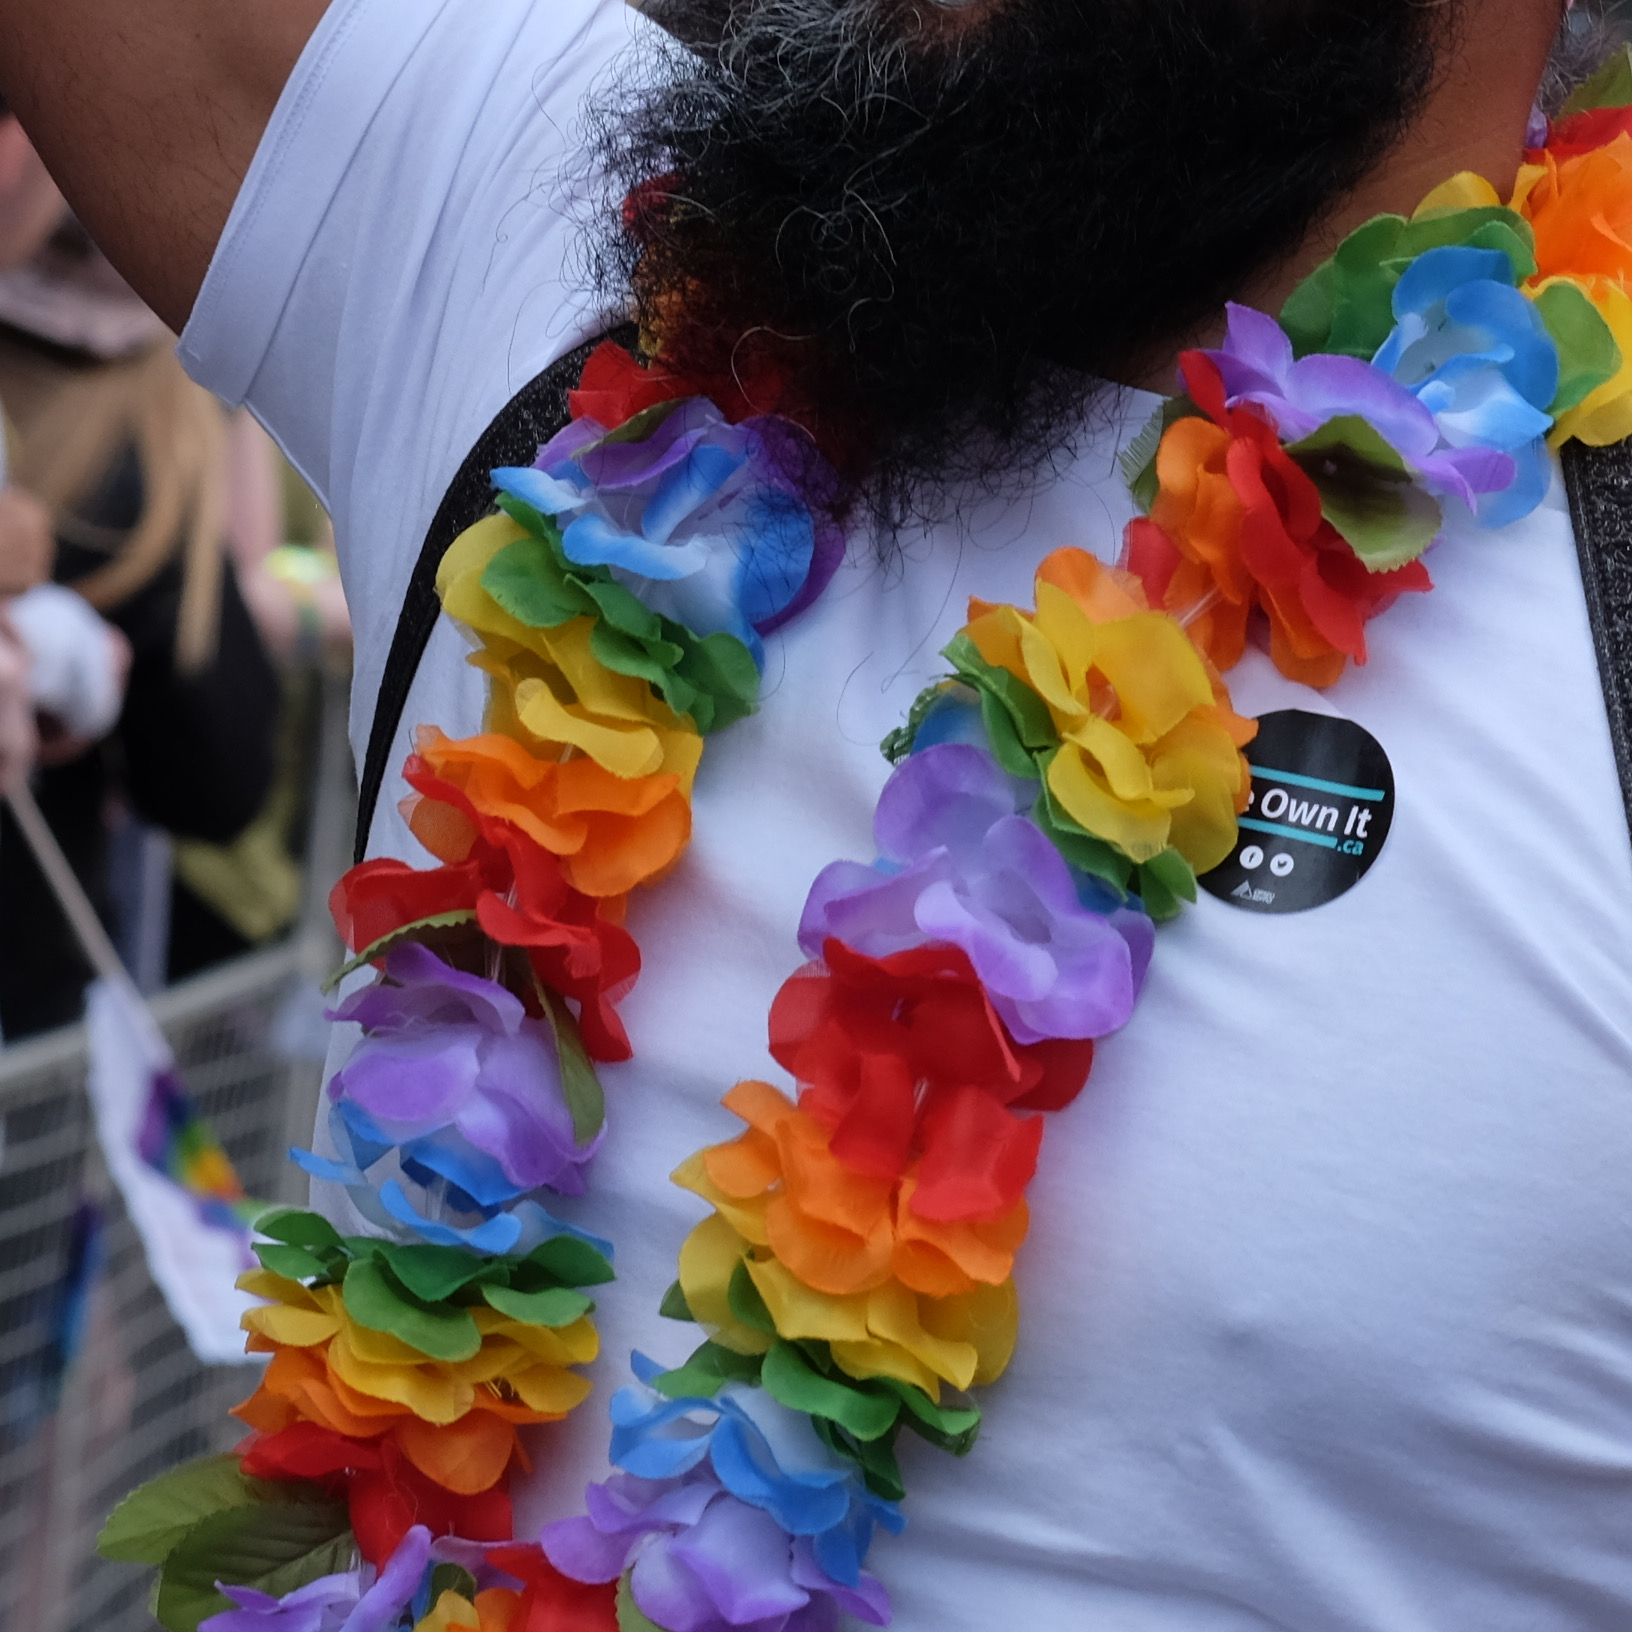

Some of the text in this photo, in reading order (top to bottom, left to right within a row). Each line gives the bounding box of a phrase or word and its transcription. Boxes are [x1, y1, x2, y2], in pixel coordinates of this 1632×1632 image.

[1260, 788, 1339, 831] Own
[1344, 805, 1372, 838] It
[1336, 839, 1364, 856] .ca
